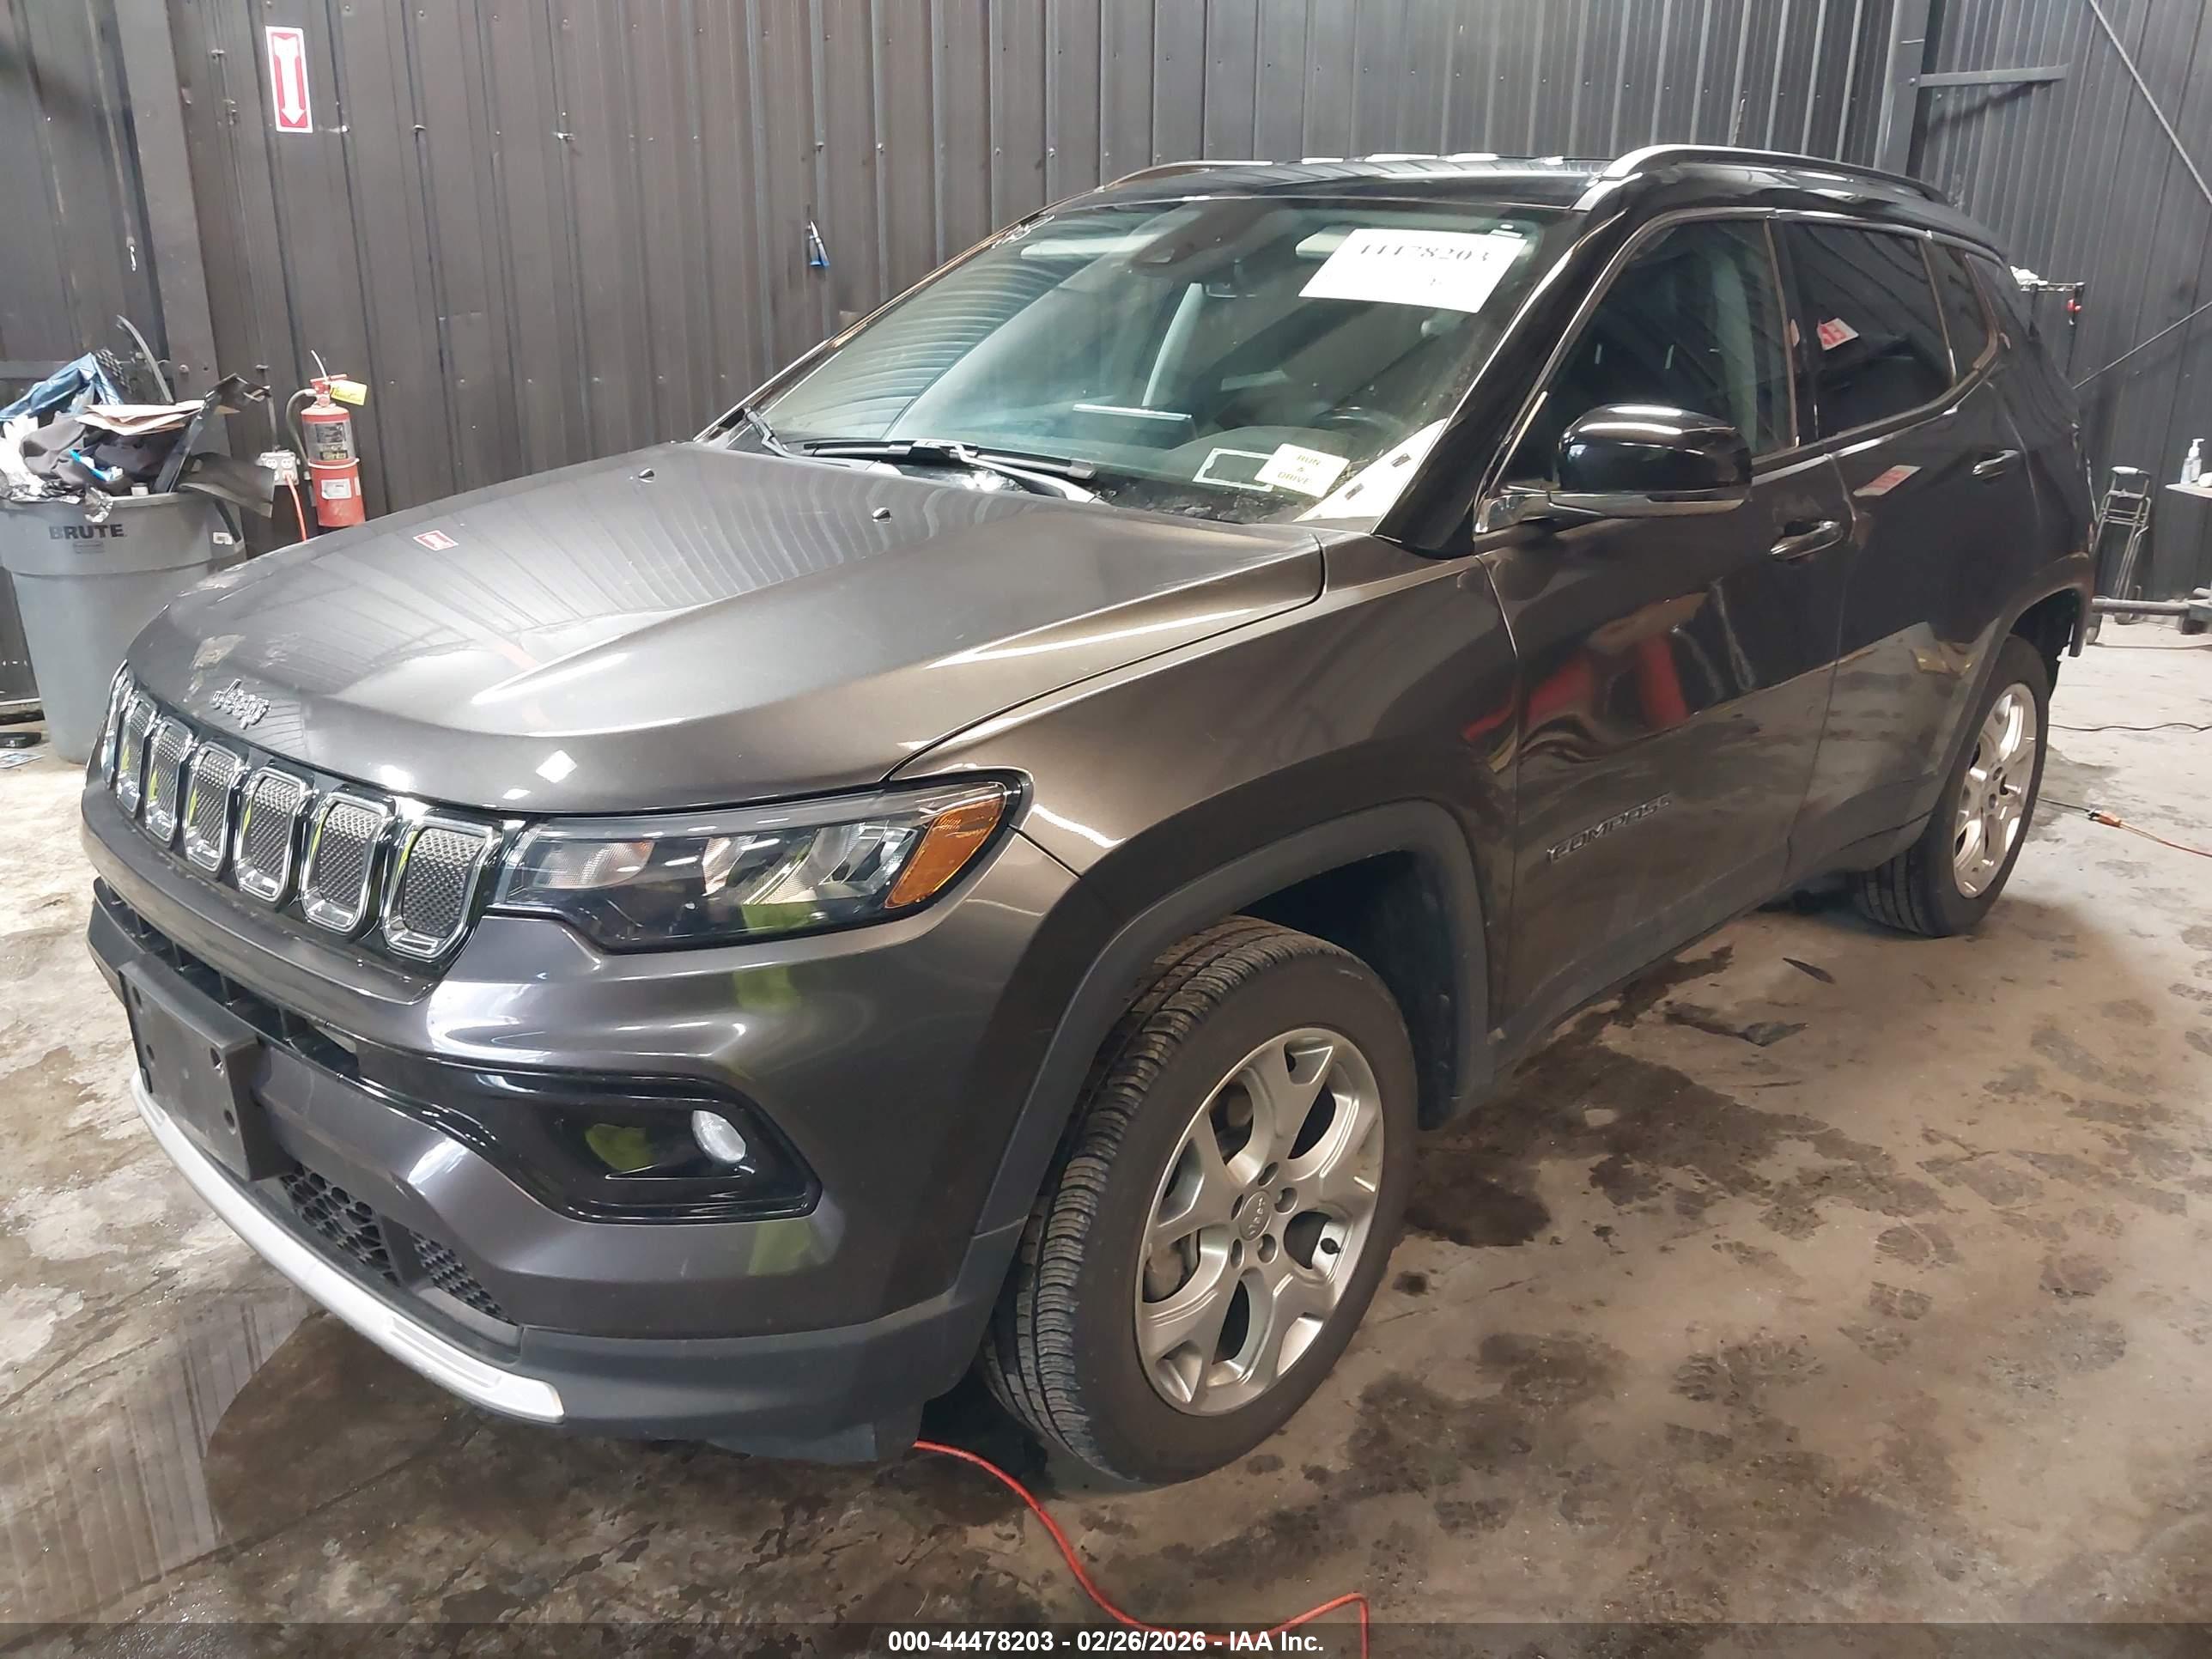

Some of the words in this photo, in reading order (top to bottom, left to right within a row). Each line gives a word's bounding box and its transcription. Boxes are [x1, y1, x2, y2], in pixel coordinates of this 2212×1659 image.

[1297, 455, 1321, 465] RUN
[1278, 472, 1311, 484] DRIVE
[49, 524, 124, 539] BRUTE
[210, 678, 270, 730] Jeep
